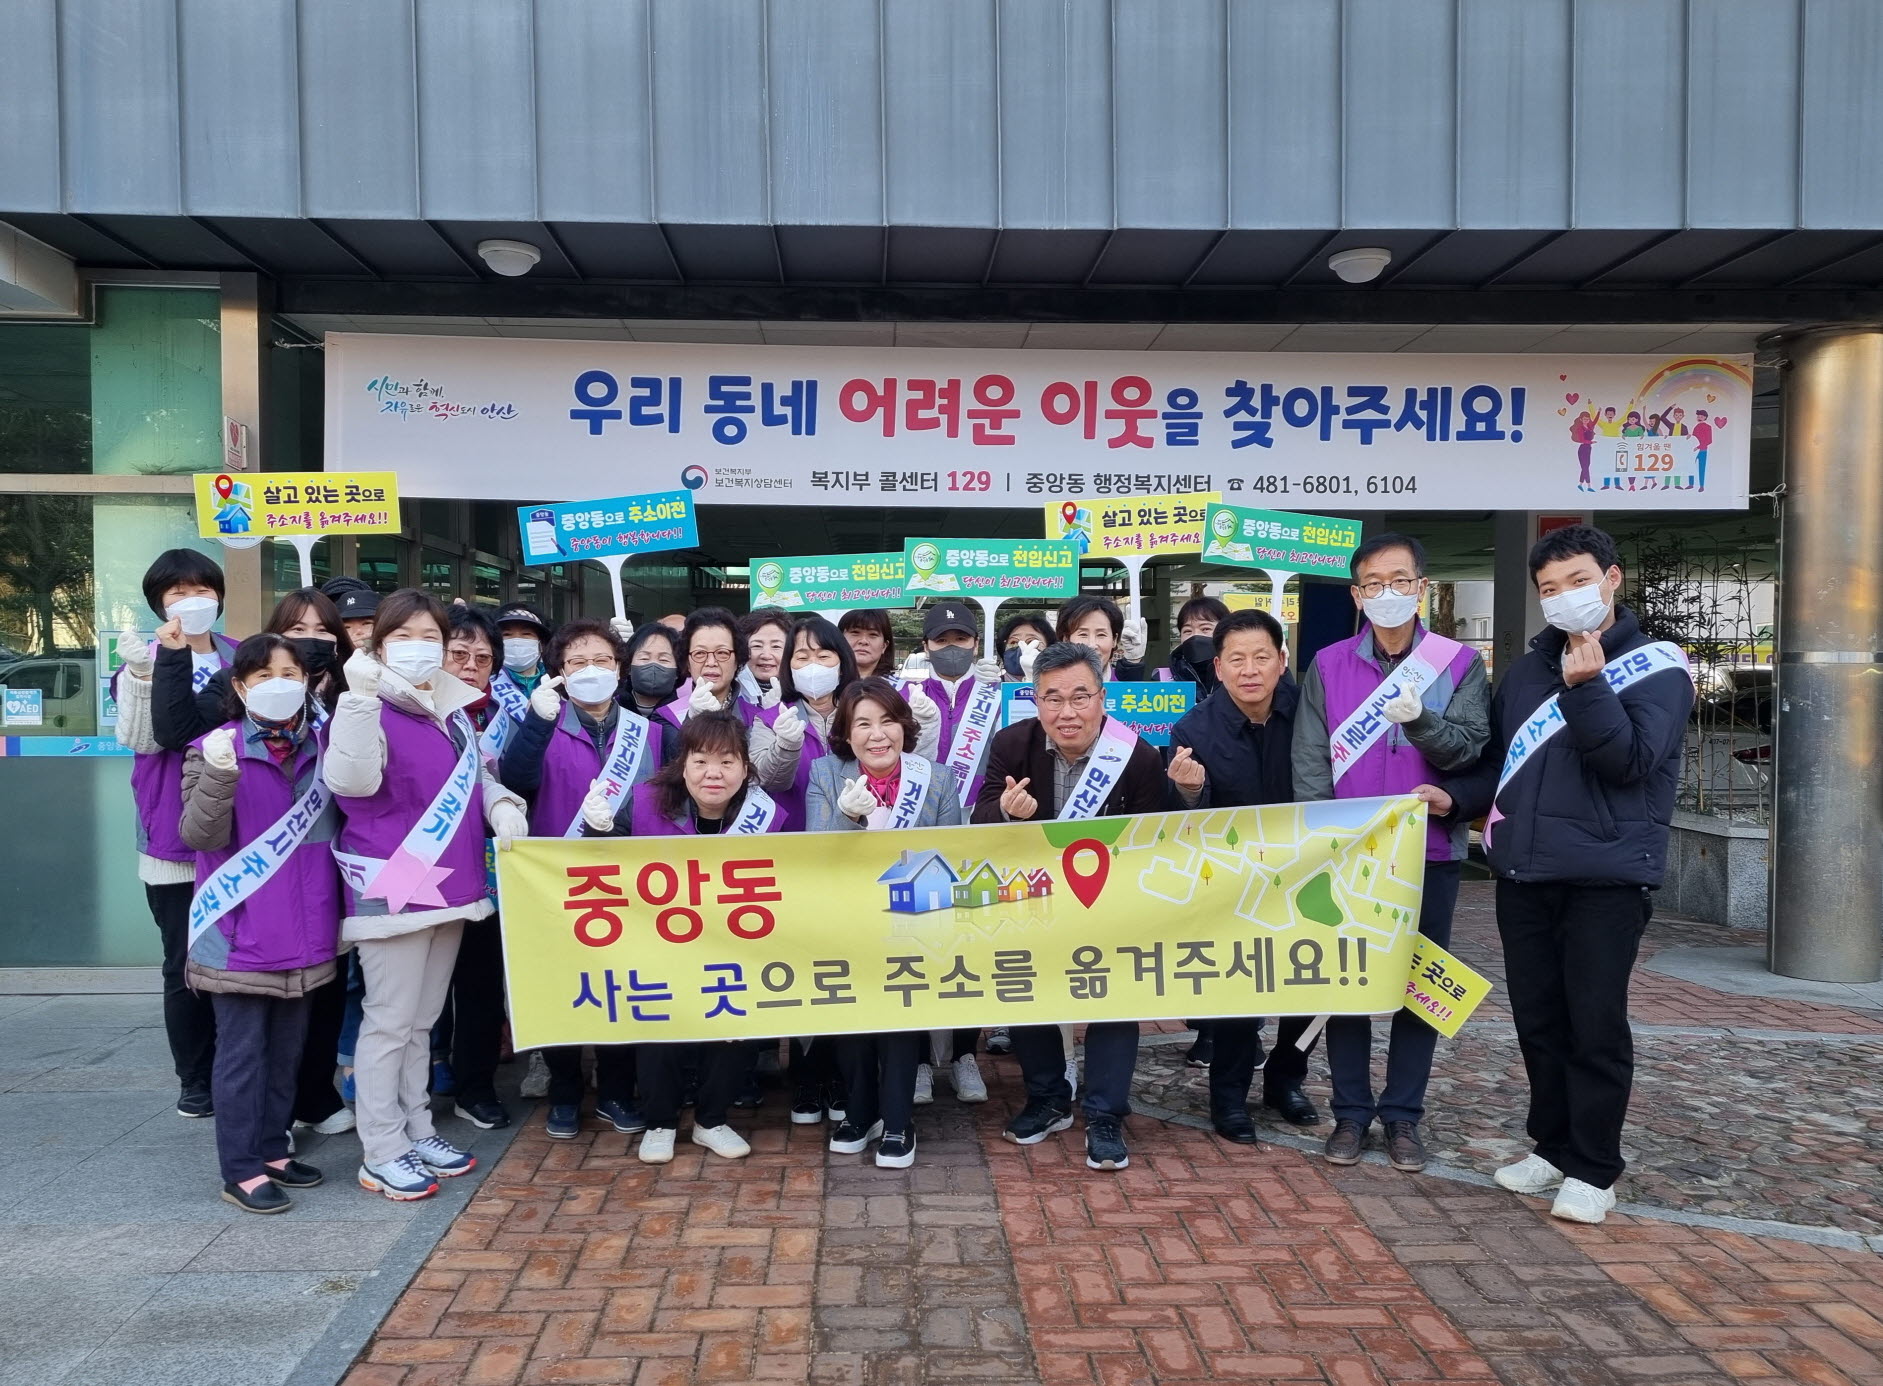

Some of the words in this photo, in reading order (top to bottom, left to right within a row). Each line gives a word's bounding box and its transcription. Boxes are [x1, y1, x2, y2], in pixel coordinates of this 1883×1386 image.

[367, 375, 411, 401] 시민과
[380, 401, 425, 421] 자유로운
[429, 402, 476, 421] 혁신도시
[480, 403, 519, 419] 안산
[569, 369, 682, 436] 우리
[703, 375, 818, 445] 동네
[838, 374, 1021, 446] 어려운
[1040, 375, 1203, 449] 이웃을
[1222, 379, 1526, 450] 찾아주세요!
[714, 467, 752, 476] 보건복지부
[1633, 453, 1674, 472] 129
[714, 477, 793, 490] 보건복지상담센터
[810, 470, 872, 492] 복지부
[878, 471, 939, 492] 콜센터
[946, 470, 991, 492] 129
[1025, 472, 1086, 495] 중앙동
[1093, 472, 1212, 495] 행정복지센터
[1252, 475, 1359, 497] 481-6801,
[1365, 475, 1418, 494] 6104
[263, 485, 300, 505] 살고
[304, 484, 340, 504] 있는
[344, 484, 385, 504] 곳으로
[266, 511, 313, 529] 주소지를
[319, 511, 388, 528] 옮겨주세요!!
[561, 511, 626, 532] 중앙동으로
[628, 500, 687, 523] 주소이전
[1101, 509, 1133, 528] 살고
[1137, 507, 1168, 526] 있는
[570, 535, 613, 552] 중앙동이
[616, 527, 683, 546] 행복합니다!!
[1103, 532, 1143, 550] 주소지를
[1243, 518, 1300, 541] 중앙동으로
[1302, 525, 1355, 548] 전입신고
[945, 548, 1009, 568] 중앙동으로
[1012, 549, 1073, 569] 전입신고
[1256, 547, 1286, 560] 당신이
[1289, 550, 1346, 567] 최고입니다!!
[789, 565, 849, 584] 중앙동으로
[851, 562, 905, 582] 전입신고
[961, 575, 995, 589] 당신이
[999, 575, 1065, 590] 최고입니다!!
[804, 589, 837, 603] 당신이
[841, 587, 902, 602] 최고입니다!!
[20, 704, 39, 713] AED
[1121, 694, 1186, 713] 주소이전
[609, 719, 642, 782] 거주지로
[956, 726, 982, 760] 주소
[264, 788, 323, 857] 안산시
[191, 850, 271, 930] 주소갖기
[563, 858, 783, 948] 중앙동
[572, 968, 673, 1024] 사는
[700, 959, 857, 1020] 곳으로
[883, 949, 1038, 1007] 주소를
[1064, 937, 1369, 1000] 옮겨주세요!!
[1421, 960, 1467, 1002] 곳으로
